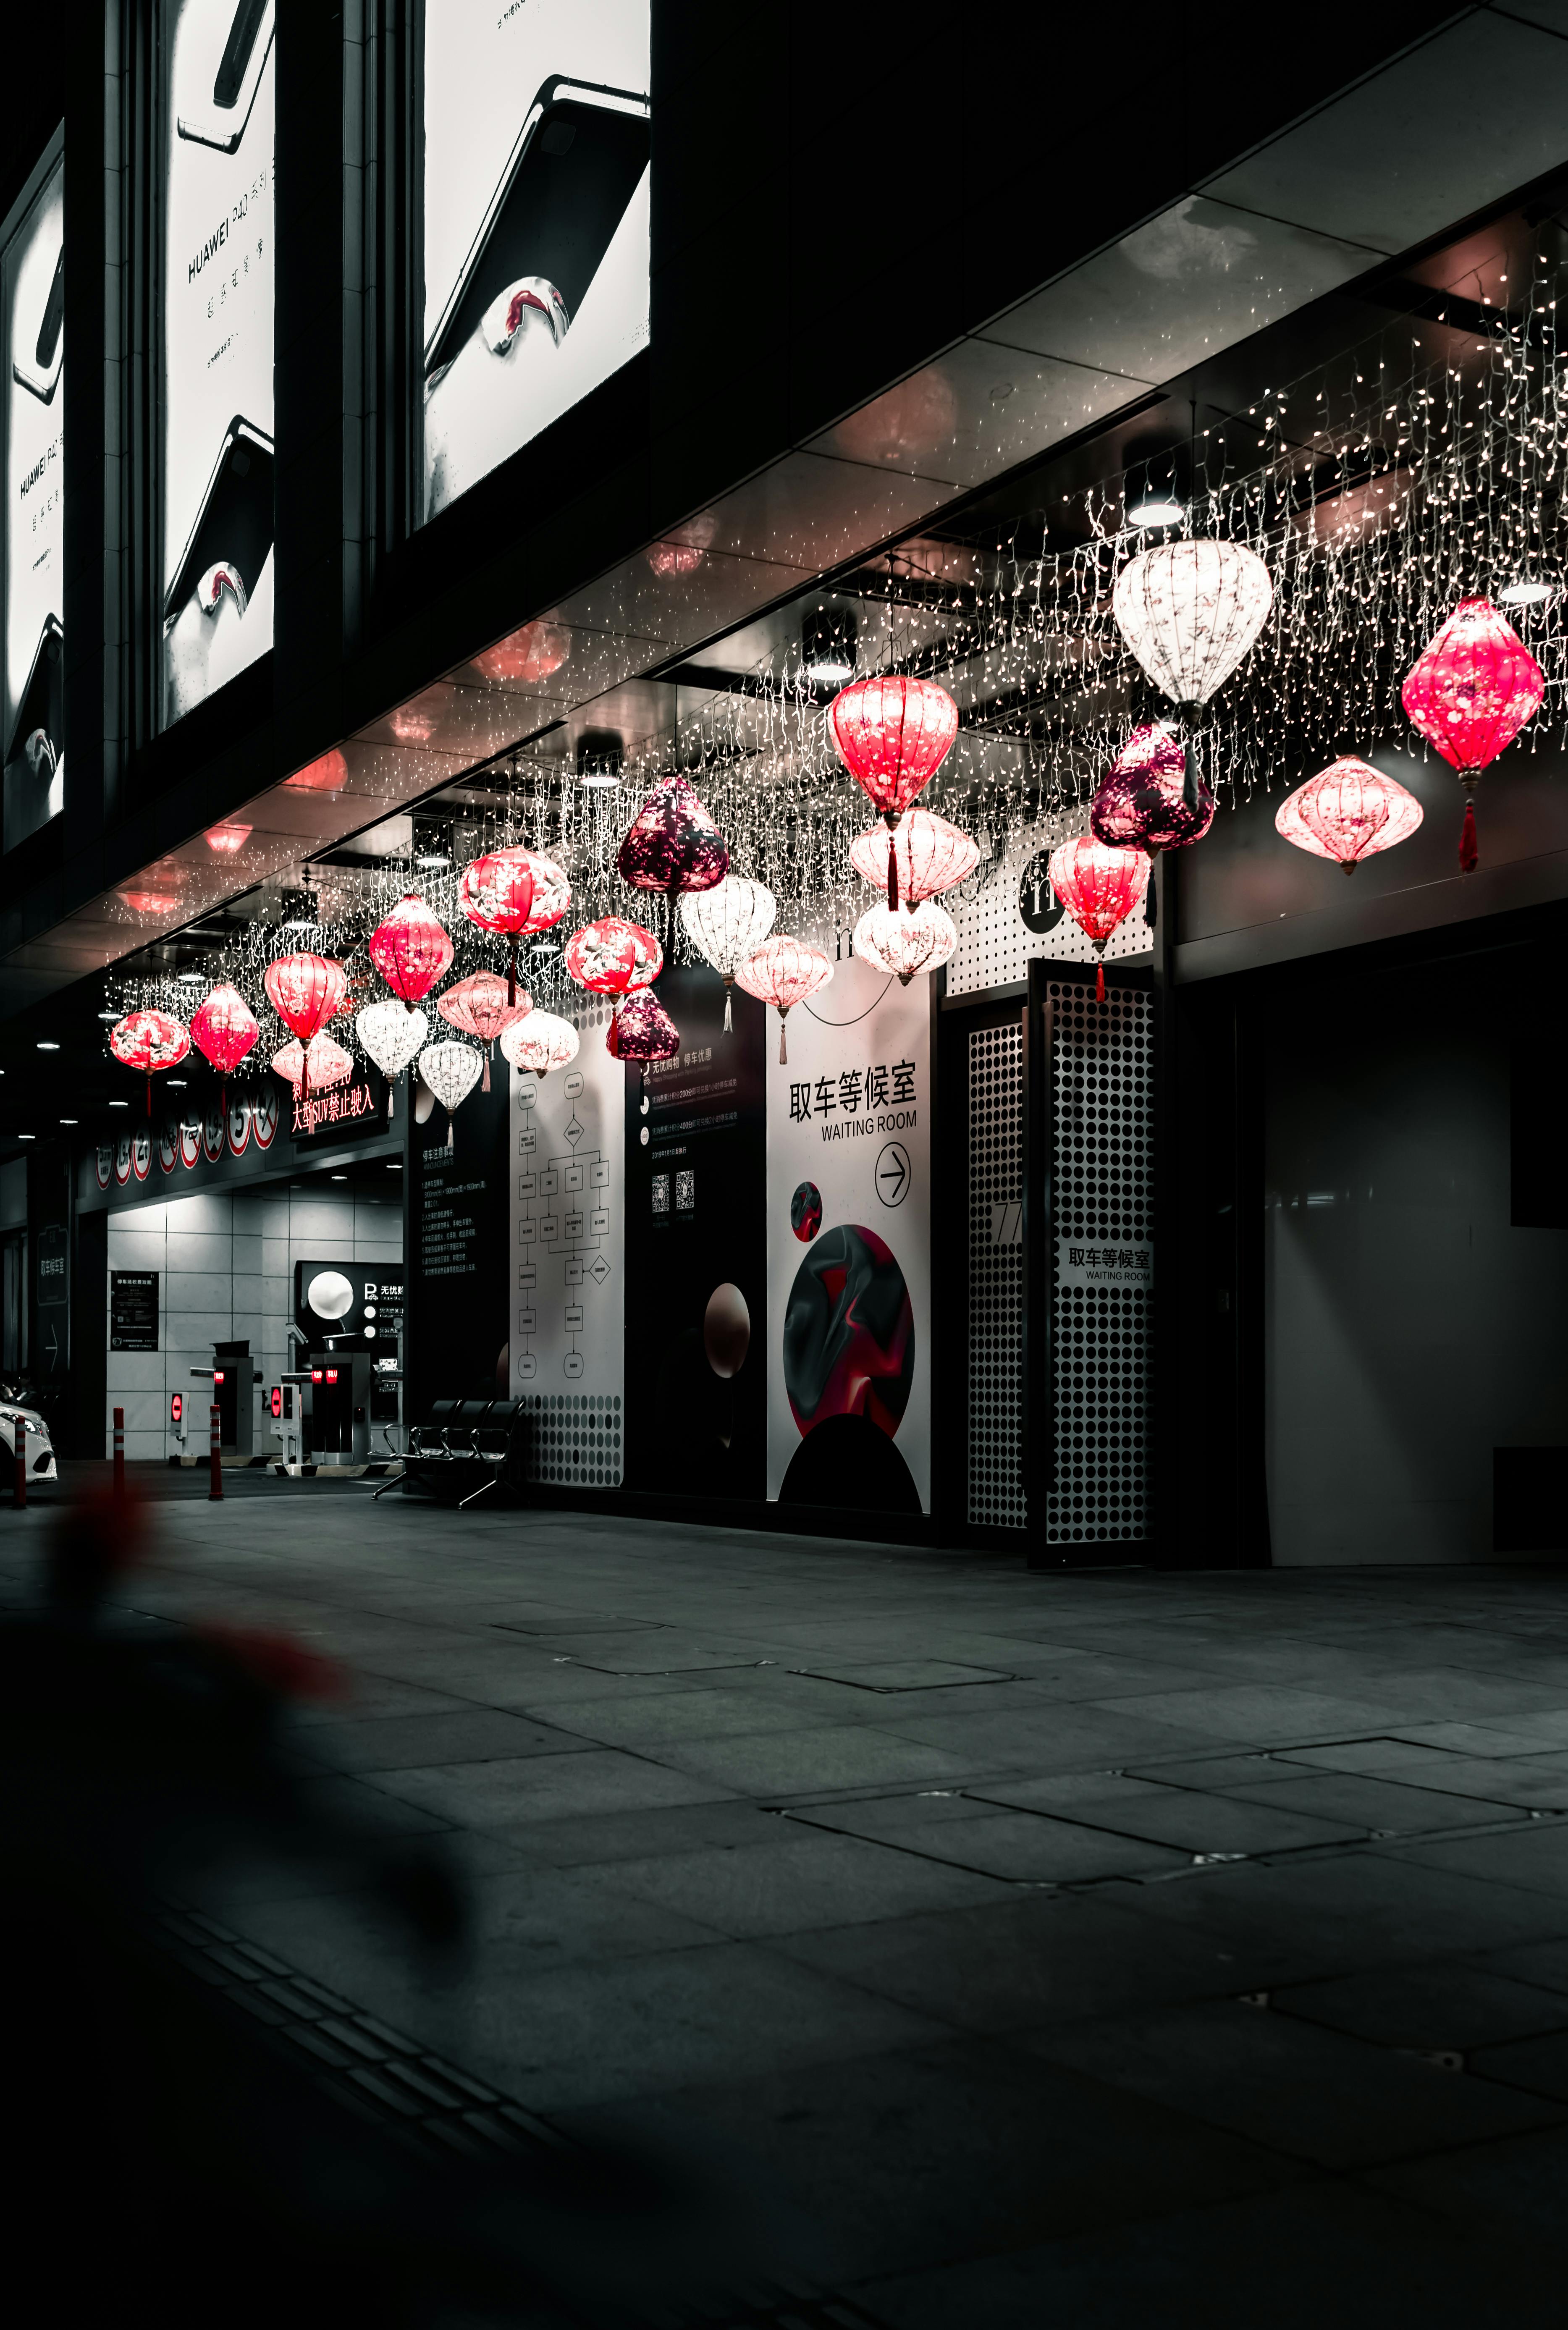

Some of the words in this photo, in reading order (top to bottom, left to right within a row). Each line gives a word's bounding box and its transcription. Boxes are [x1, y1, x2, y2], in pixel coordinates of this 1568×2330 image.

[189, 218, 229, 283] HUAWEI
[21, 454, 46, 500] HUAWEI
[684, 1048, 712, 1067] 停车优惠
[789, 1059, 916, 1123] 取车等候室
[235, 1097, 244, 1138] 5
[292, 1084, 374, 1132] 大型SUV禁止驶入
[821, 1118, 874, 1142] WAITING
[877, 1110, 917, 1132] ROOM
[137, 1132, 148, 1161] 2t
[652, 1146, 687, 1159] 2019年1月1日起执行
[995, 1201, 1022, 1242] 77
[1069, 1248, 1150, 1269] 取车等候室
[364, 1283, 377, 1300] P
[1086, 1271, 1122, 1280] WAITING
[1124, 1272, 1150, 1281] ROOM
